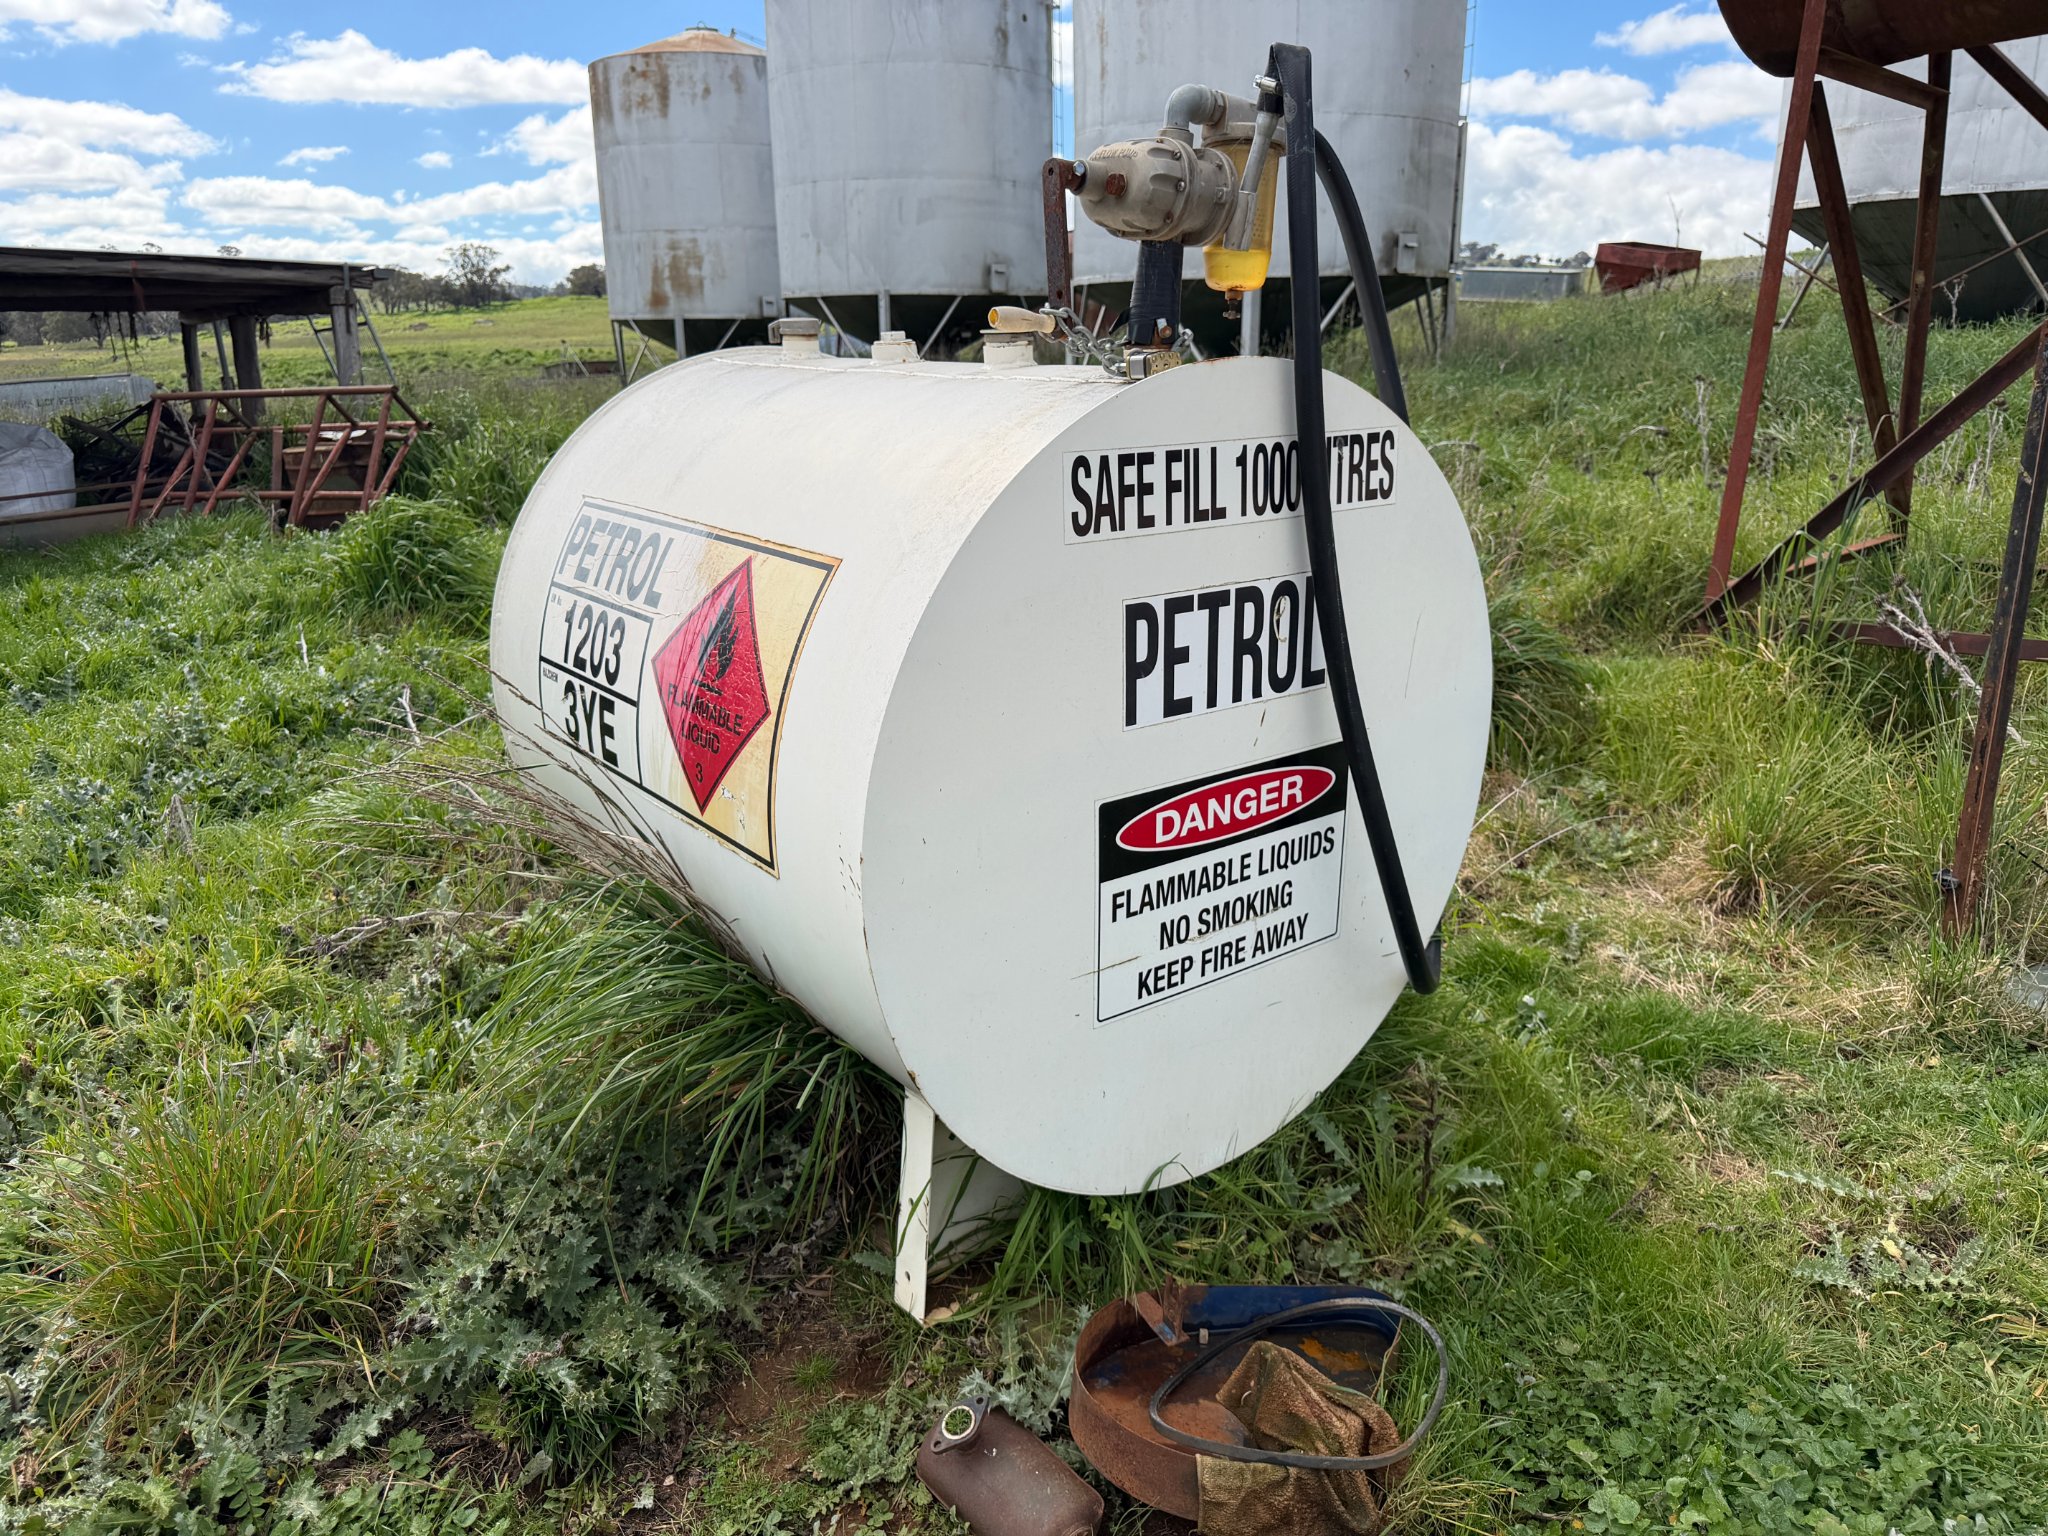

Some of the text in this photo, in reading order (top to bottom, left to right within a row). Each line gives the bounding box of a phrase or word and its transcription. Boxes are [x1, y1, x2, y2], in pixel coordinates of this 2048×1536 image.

[1071, 430, 1395, 537] SAFE FILL 1000 ITRES
[558, 513, 675, 609] PETROL
[563, 599, 626, 686] 1203
[1125, 575, 1326, 727] PETROL
[563, 679, 619, 768] 3YE
[667, 682, 744, 737] FLAMMABLE
[681, 717, 721, 755] LIQUID
[695, 762, 704, 783] 3
[1155, 774, 1303, 844] DANGER
[1111, 826, 1335, 923] FLAMMABLE LIQUIDS
[1159, 880, 1293, 950] NO SMOKING
[1137, 912, 1309, 1000] KEEP FIRE AWAY
